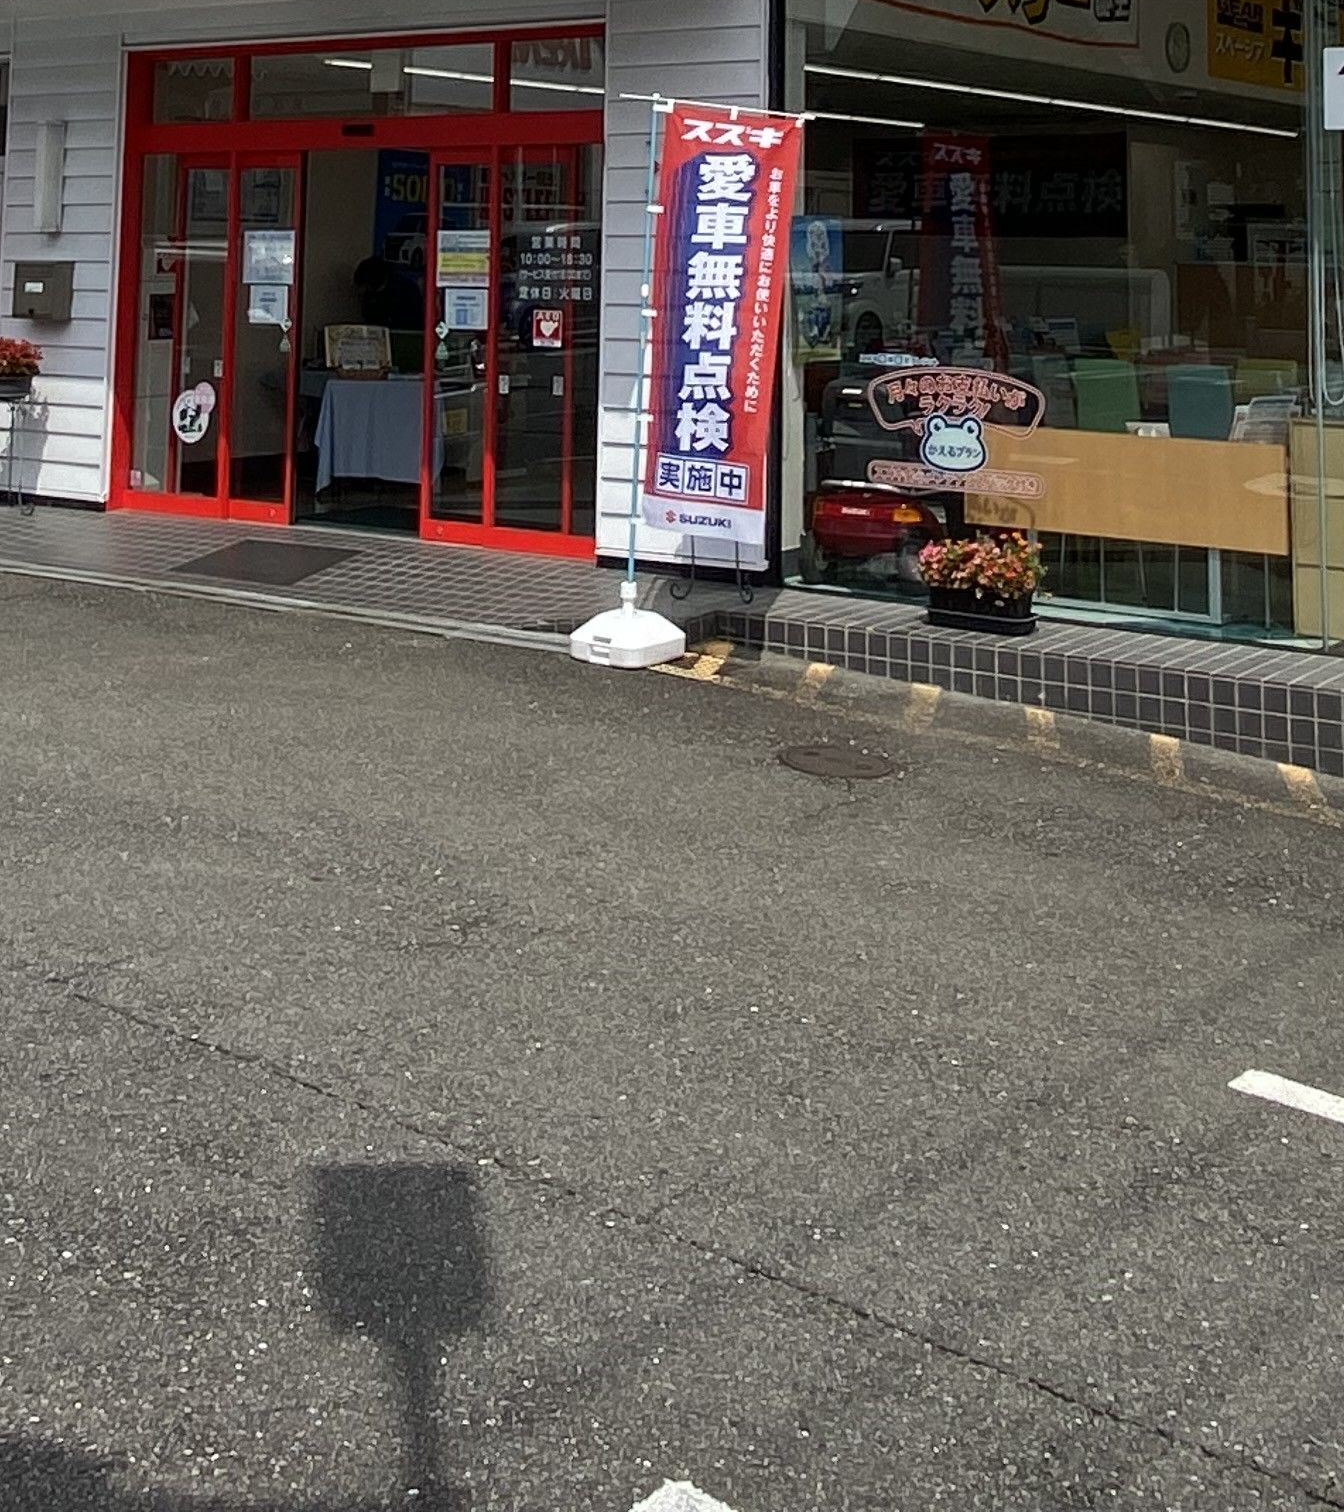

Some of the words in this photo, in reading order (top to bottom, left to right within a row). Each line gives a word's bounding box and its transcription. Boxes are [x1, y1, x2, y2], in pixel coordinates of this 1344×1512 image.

[678, 118, 784, 148] スズキ
[674, 153, 755, 454] 愛車無料点検
[658, 460, 743, 497] 実施中
[678, 512, 732, 529] SUZUKI
